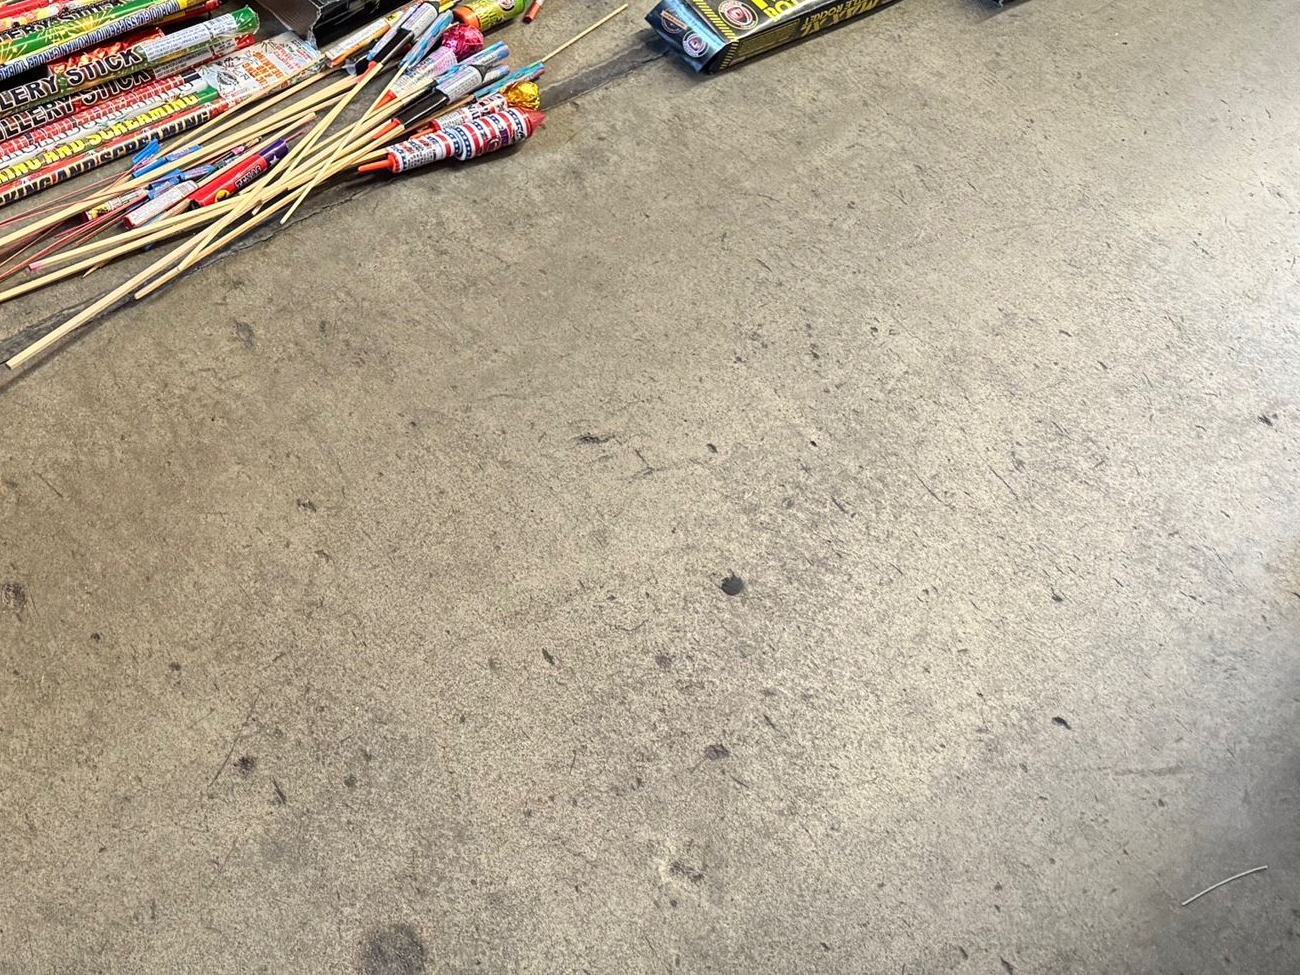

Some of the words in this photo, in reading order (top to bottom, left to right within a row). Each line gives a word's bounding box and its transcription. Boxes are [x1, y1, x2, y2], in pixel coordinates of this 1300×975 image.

[88, 19, 126, 44] PREMIUM
[124, 9, 151, 30] CLASS
[27, 45, 61, 68] CANDLE
[59, 33, 90, 55] ROMAN
[65, 45, 144, 88] STICK
[81, 69, 152, 106] STICK
[43, 139, 86, 163] AND
[87, 92, 200, 146] SCREAMING
[56, 155, 98, 185] AND
